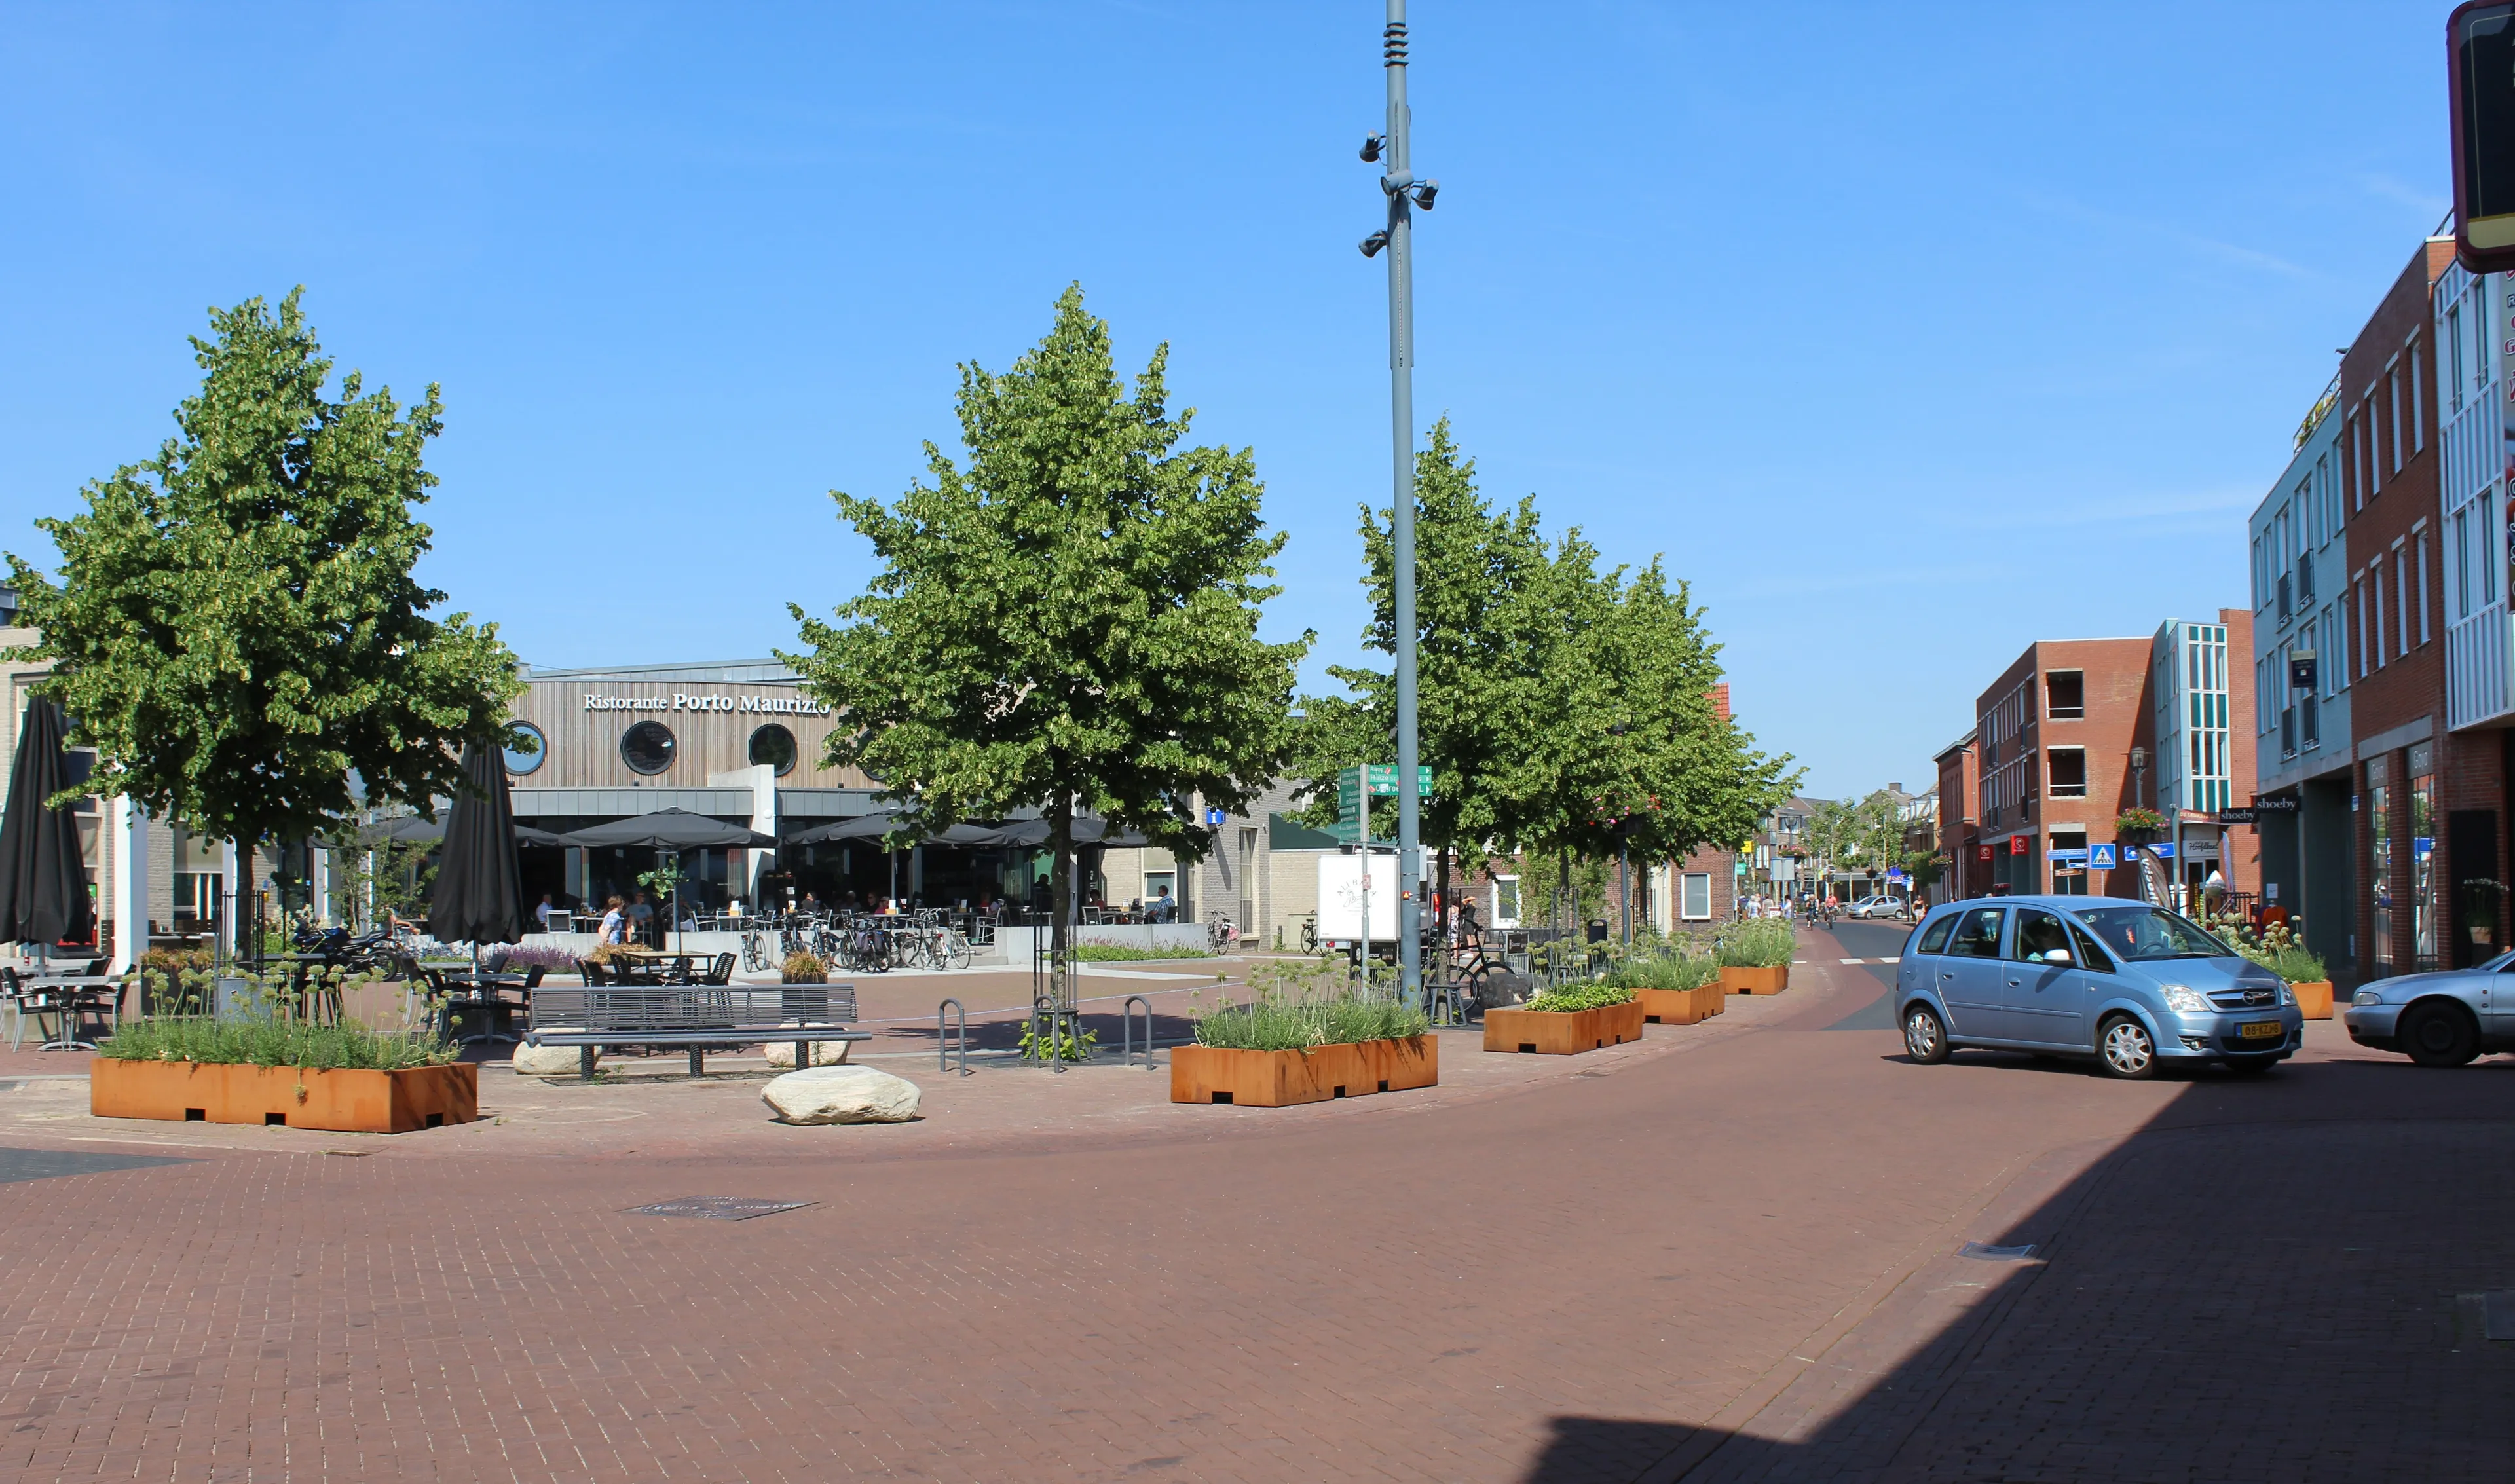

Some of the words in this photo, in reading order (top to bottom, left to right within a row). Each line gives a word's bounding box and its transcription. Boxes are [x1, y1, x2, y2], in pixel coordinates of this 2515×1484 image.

[584, 694, 667, 709] Ristorante
[673, 693, 734, 711] Porto
[2256, 797, 2297, 810] shoeby
[2221, 809, 2255, 821] shoeby
